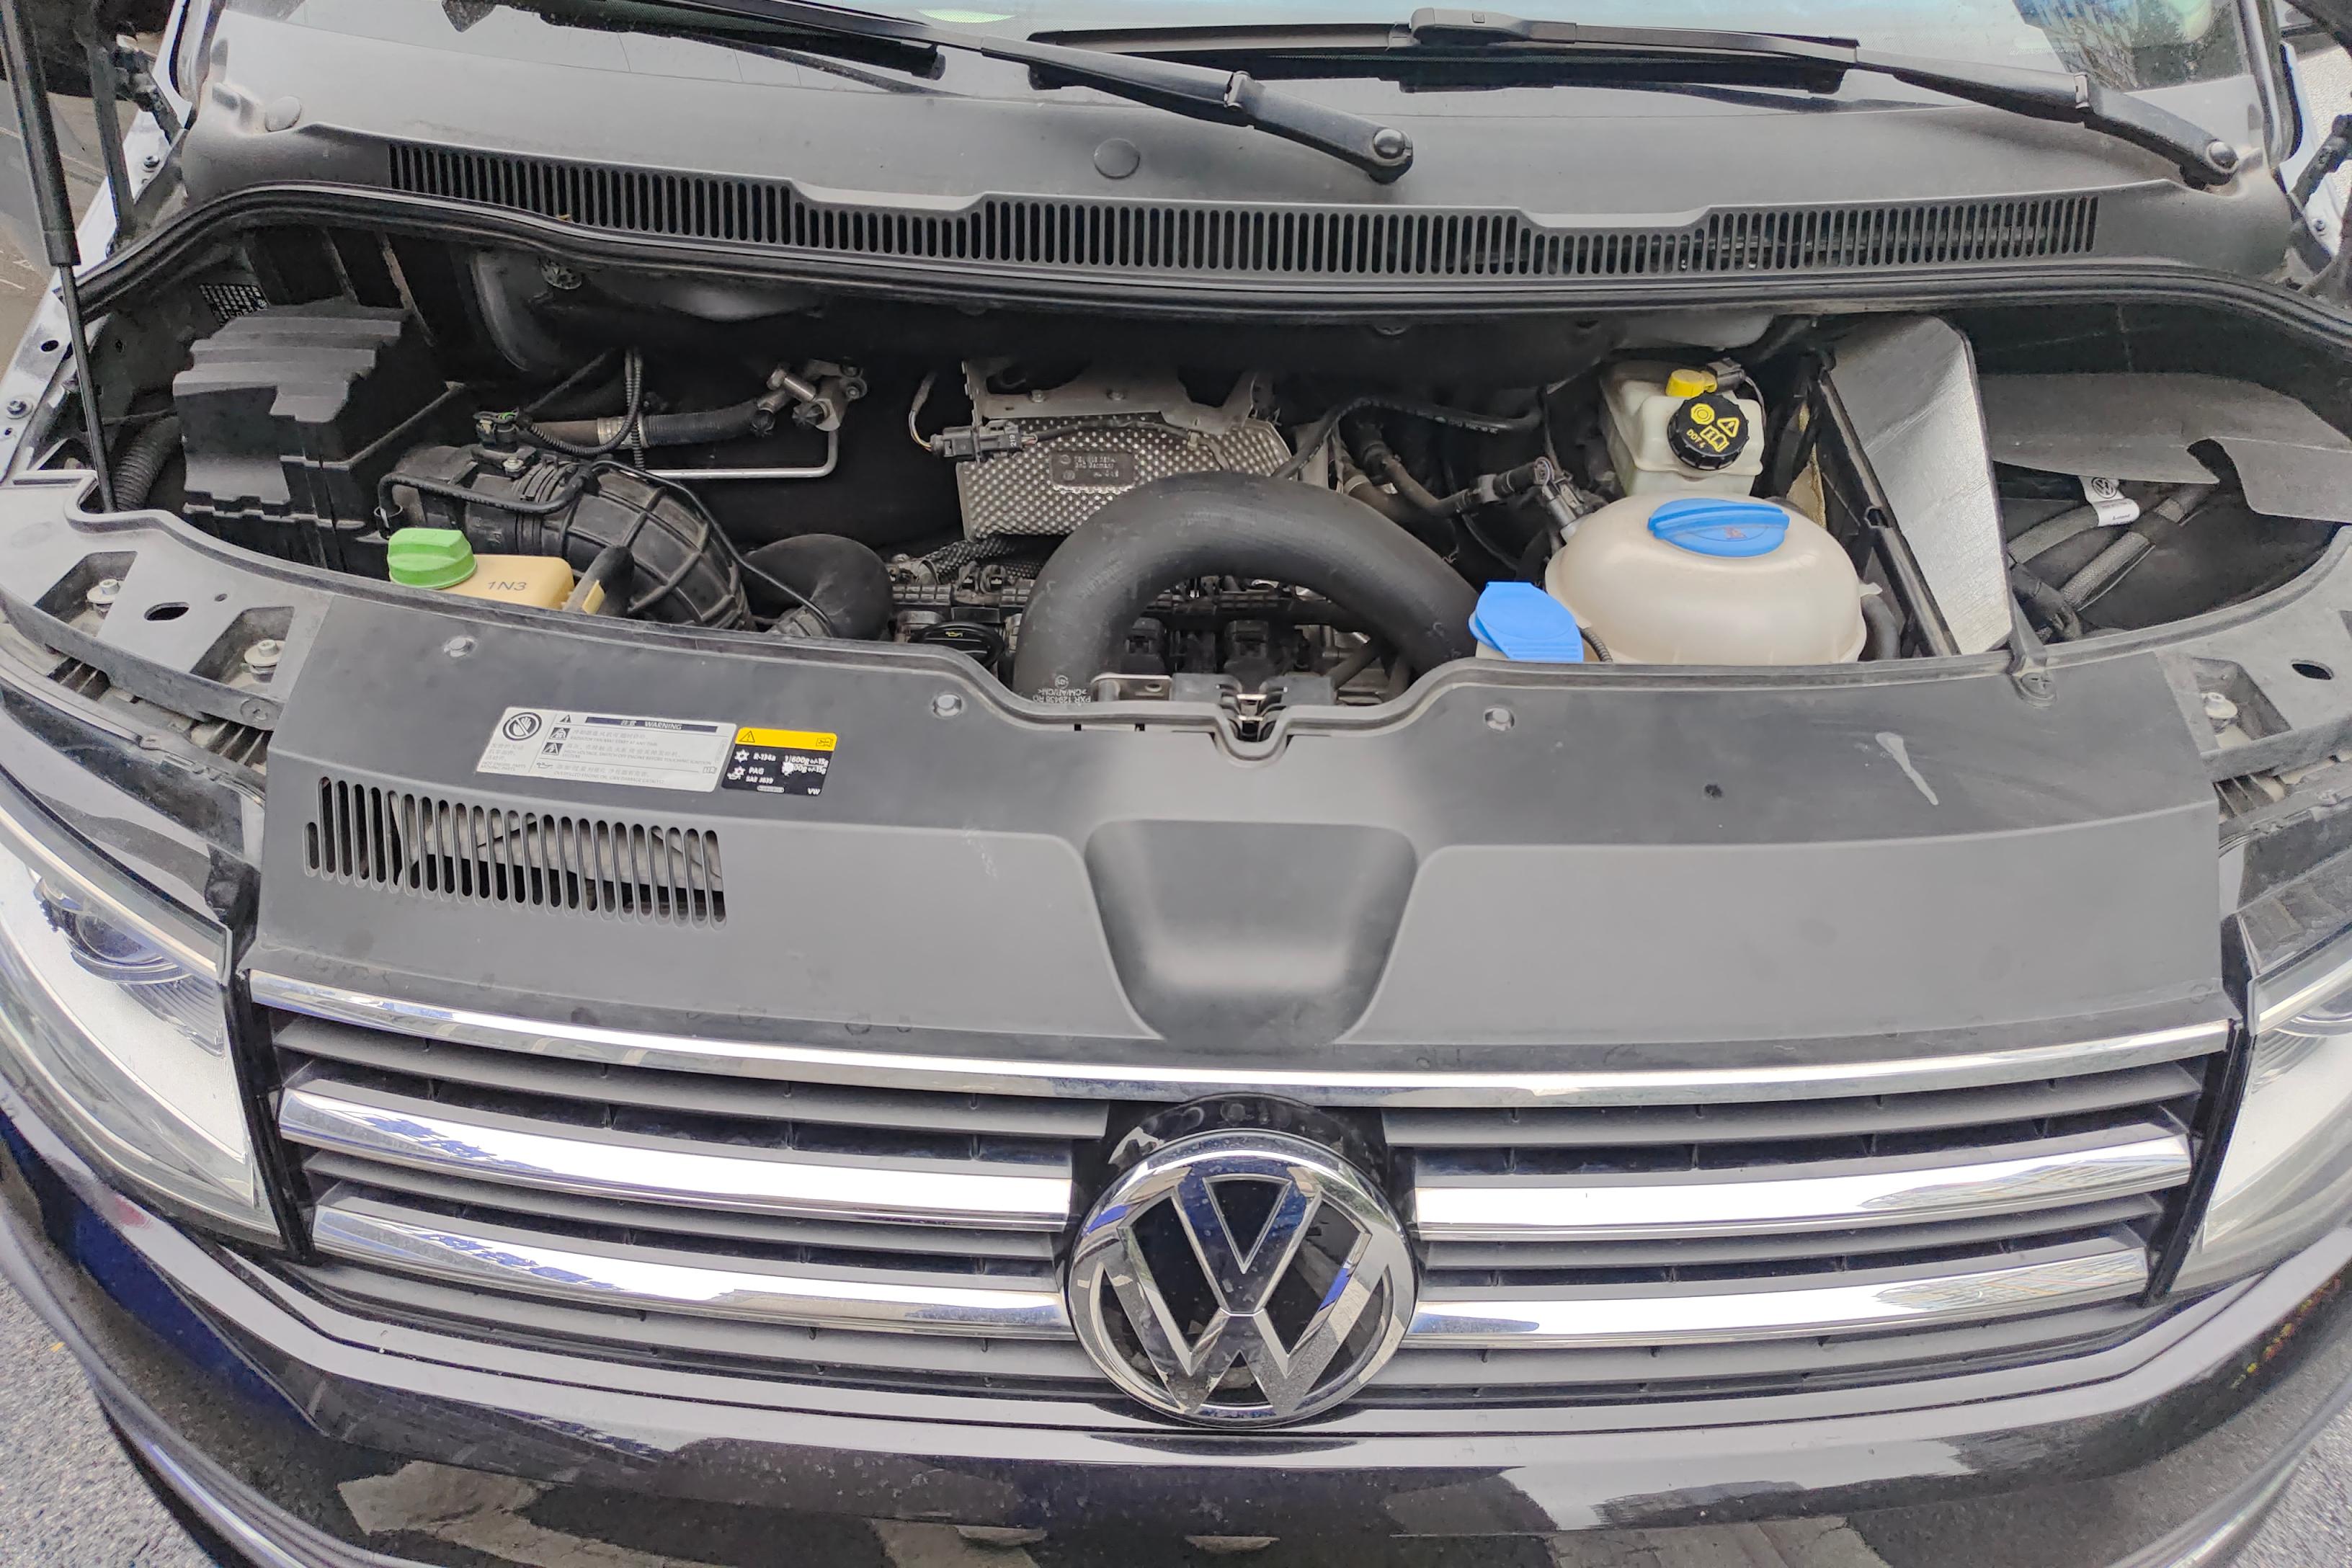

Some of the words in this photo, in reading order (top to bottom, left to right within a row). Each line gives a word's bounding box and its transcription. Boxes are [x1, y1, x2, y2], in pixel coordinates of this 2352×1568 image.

[1686, 429, 1702, 442] DOT
[488, 581, 527, 591] 1N3
[644, 721, 683, 731] WARNING
[748, 767, 765, 775] PAG
[807, 787, 821, 796] VW
[1074, 1147, 1412, 1421] VW
